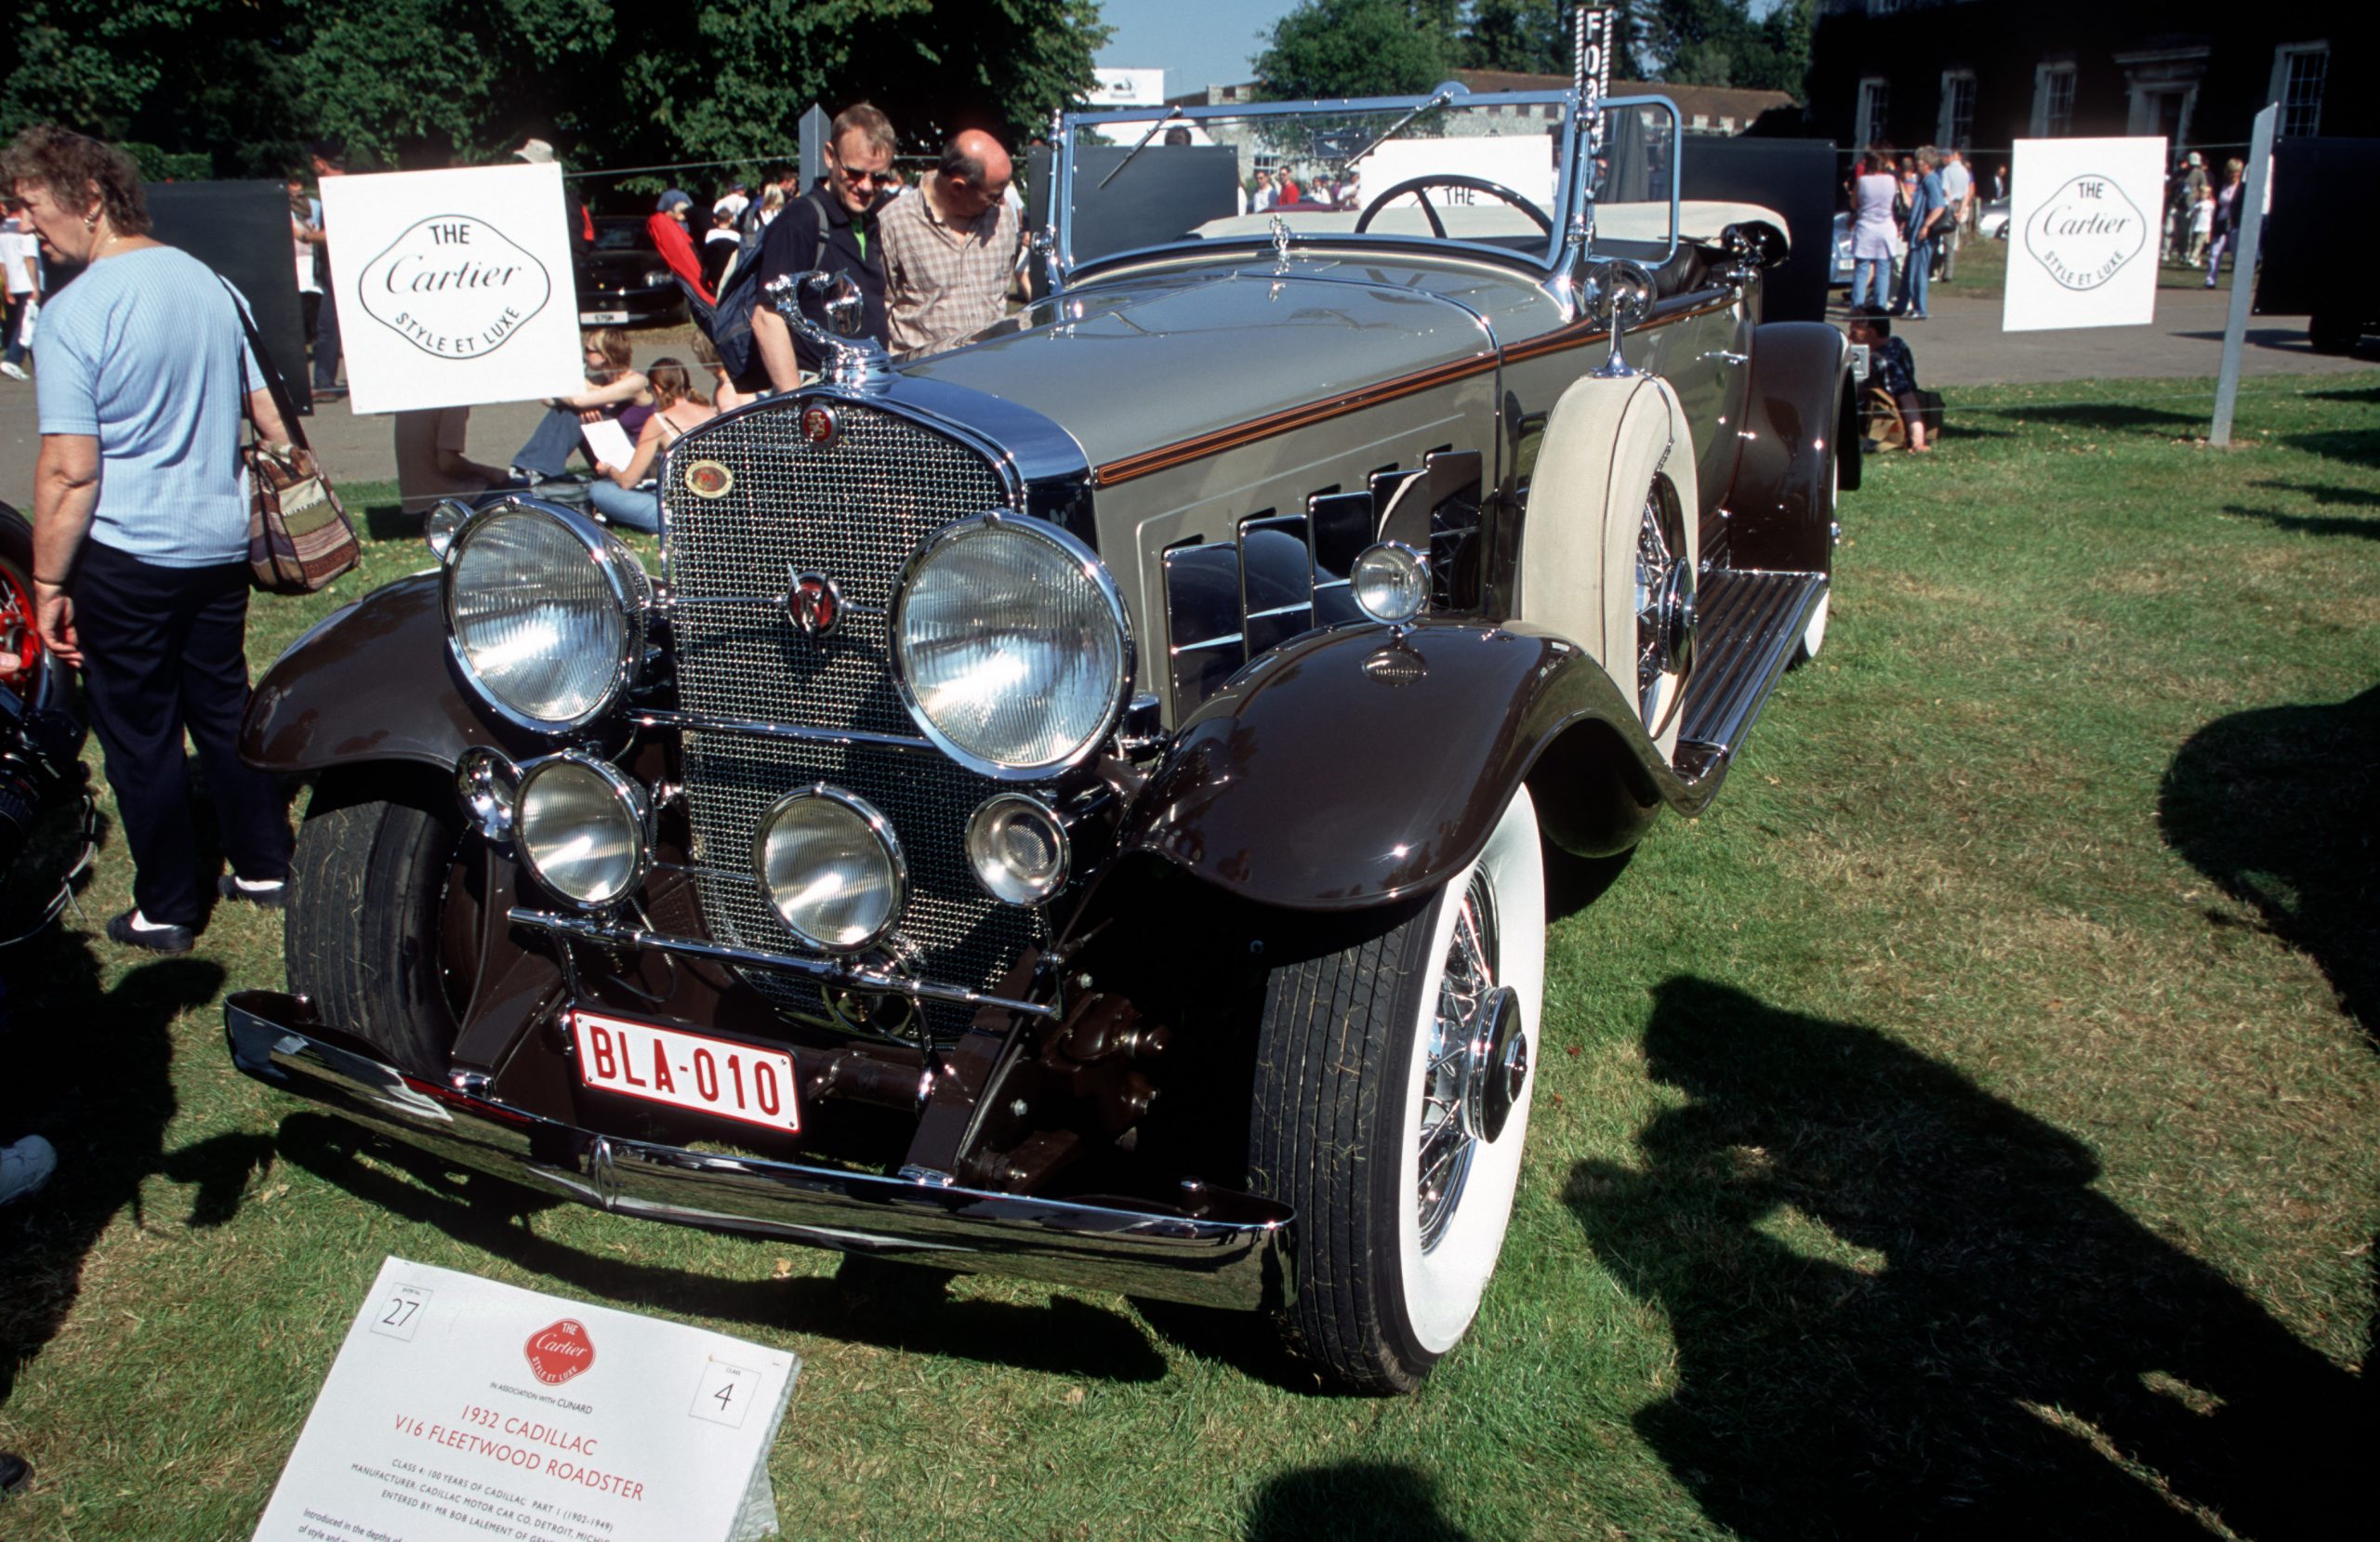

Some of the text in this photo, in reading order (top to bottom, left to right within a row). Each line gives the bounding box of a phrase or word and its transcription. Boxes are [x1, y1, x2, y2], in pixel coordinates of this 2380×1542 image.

[1443, 187, 1475, 205] THE
[2078, 182, 2104, 199] THE
[428, 223, 470, 245] THE
[2043, 204, 2131, 236] Cartier
[386, 254, 522, 295] Cartier
[2044, 250, 2123, 285] STYLE ET LUXE
[395, 306, 521, 353] STYLE ET LUXE
[589, 1025, 780, 1116] BLA-010
[382, 1298, 420, 1326] 27
[536, 1332, 588, 1357] Cartier
[562, 1323, 578, 1335] THE
[532, 1356, 578, 1382] STYLE ET LUXE
[498, 1383, 537, 1400] ASSOCIATION
[538, 1395, 556, 1404] WITH
[557, 1398, 593, 1415] CUNARD
[714, 1383, 734, 1411] 4
[461, 1404, 598, 1456] 1932 CADILLAC
[395, 1414, 644, 1501] V16 FLEETWOOD ROADSTER
[391, 1458, 416, 1472] CLASS
[427, 1470, 441, 1481] 100
[443, 1474, 469, 1487] YEARS
[469, 1483, 483, 1492] OF
[483, 1487, 526, 1506] CADILLAC
[532, 1500, 554, 1513] PART
[563, 1510, 614, 1533] (1902-1949)
[419, 1484, 462, 1503] CADILLAC
[463, 1497, 494, 1513] MOTOR
[496, 1508, 513, 1520] CAR
[303, 1508, 344, 1529] Introduced
[352, 1524, 364, 1535] the
[366, 1529, 390, 1542] depths
[381, 1489, 418, 1508] ENTERED
[434, 1506, 447, 1516] MR
[449, 1510, 468, 1522] BOB
[469, 1517, 512, 1535] LALEMENT
[515, 1531, 527, 1540] OF
[298, 1525, 308, 1534] of
[308, 1527, 324, 1540] style
